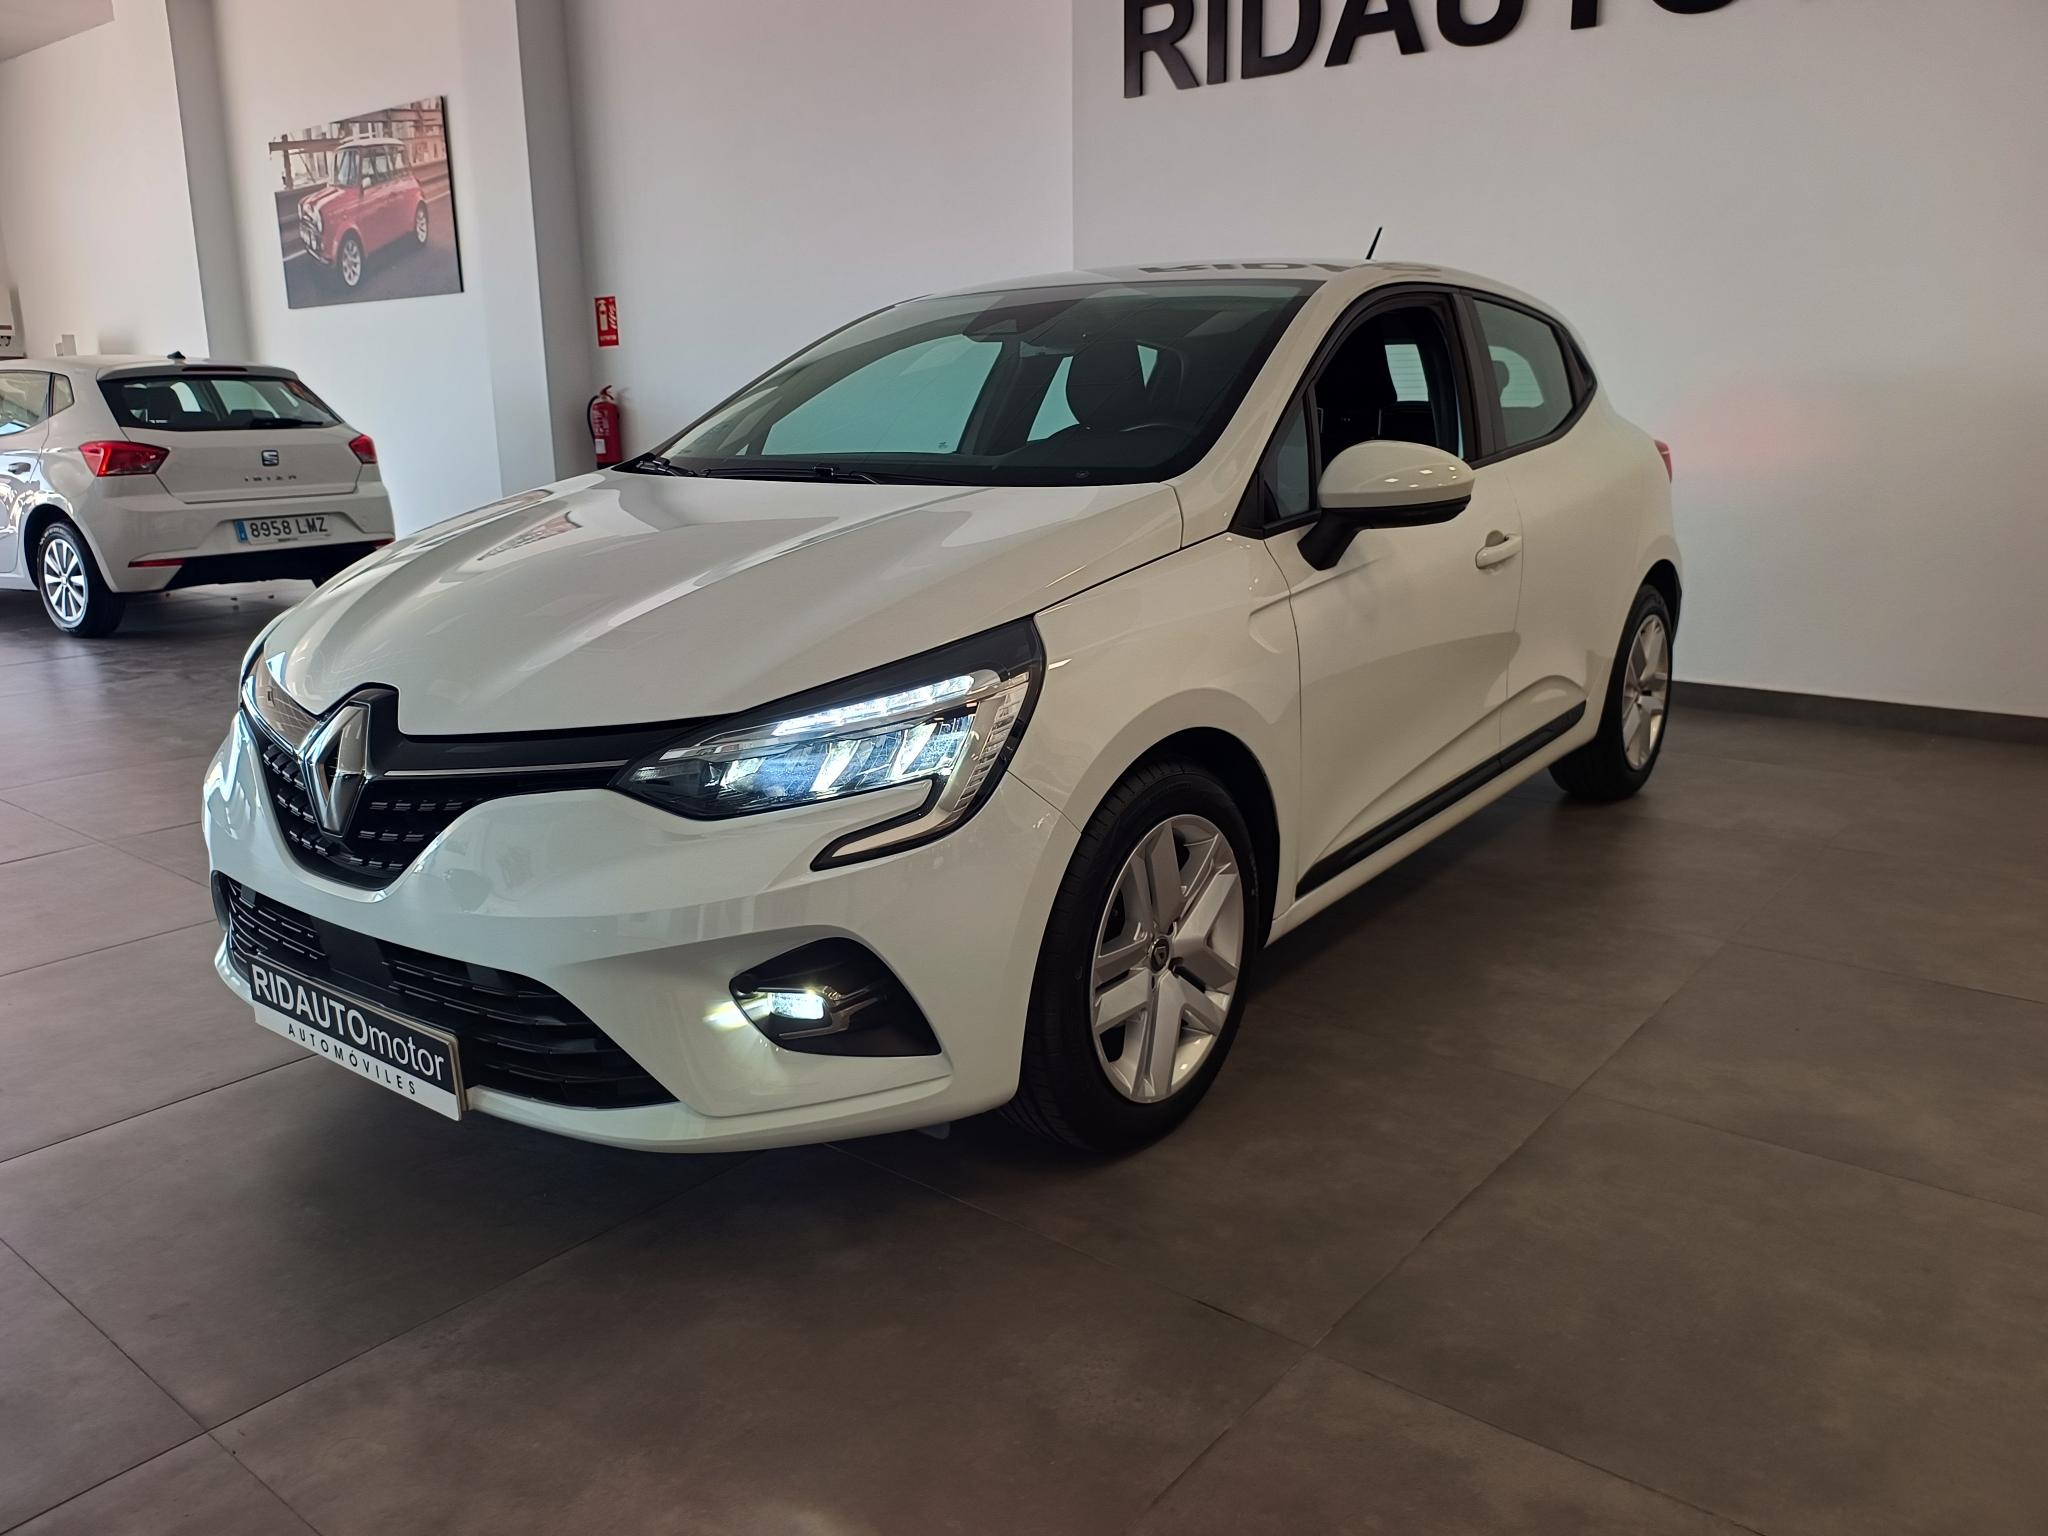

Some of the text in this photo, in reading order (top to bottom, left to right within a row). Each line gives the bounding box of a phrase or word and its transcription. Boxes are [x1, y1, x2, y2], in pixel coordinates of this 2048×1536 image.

[250, 517, 328, 538] 8958 LMZ
[252, 963, 444, 1080] RIDAUTOmotor
[288, 1023, 415, 1095] AUTOMÓVILES
